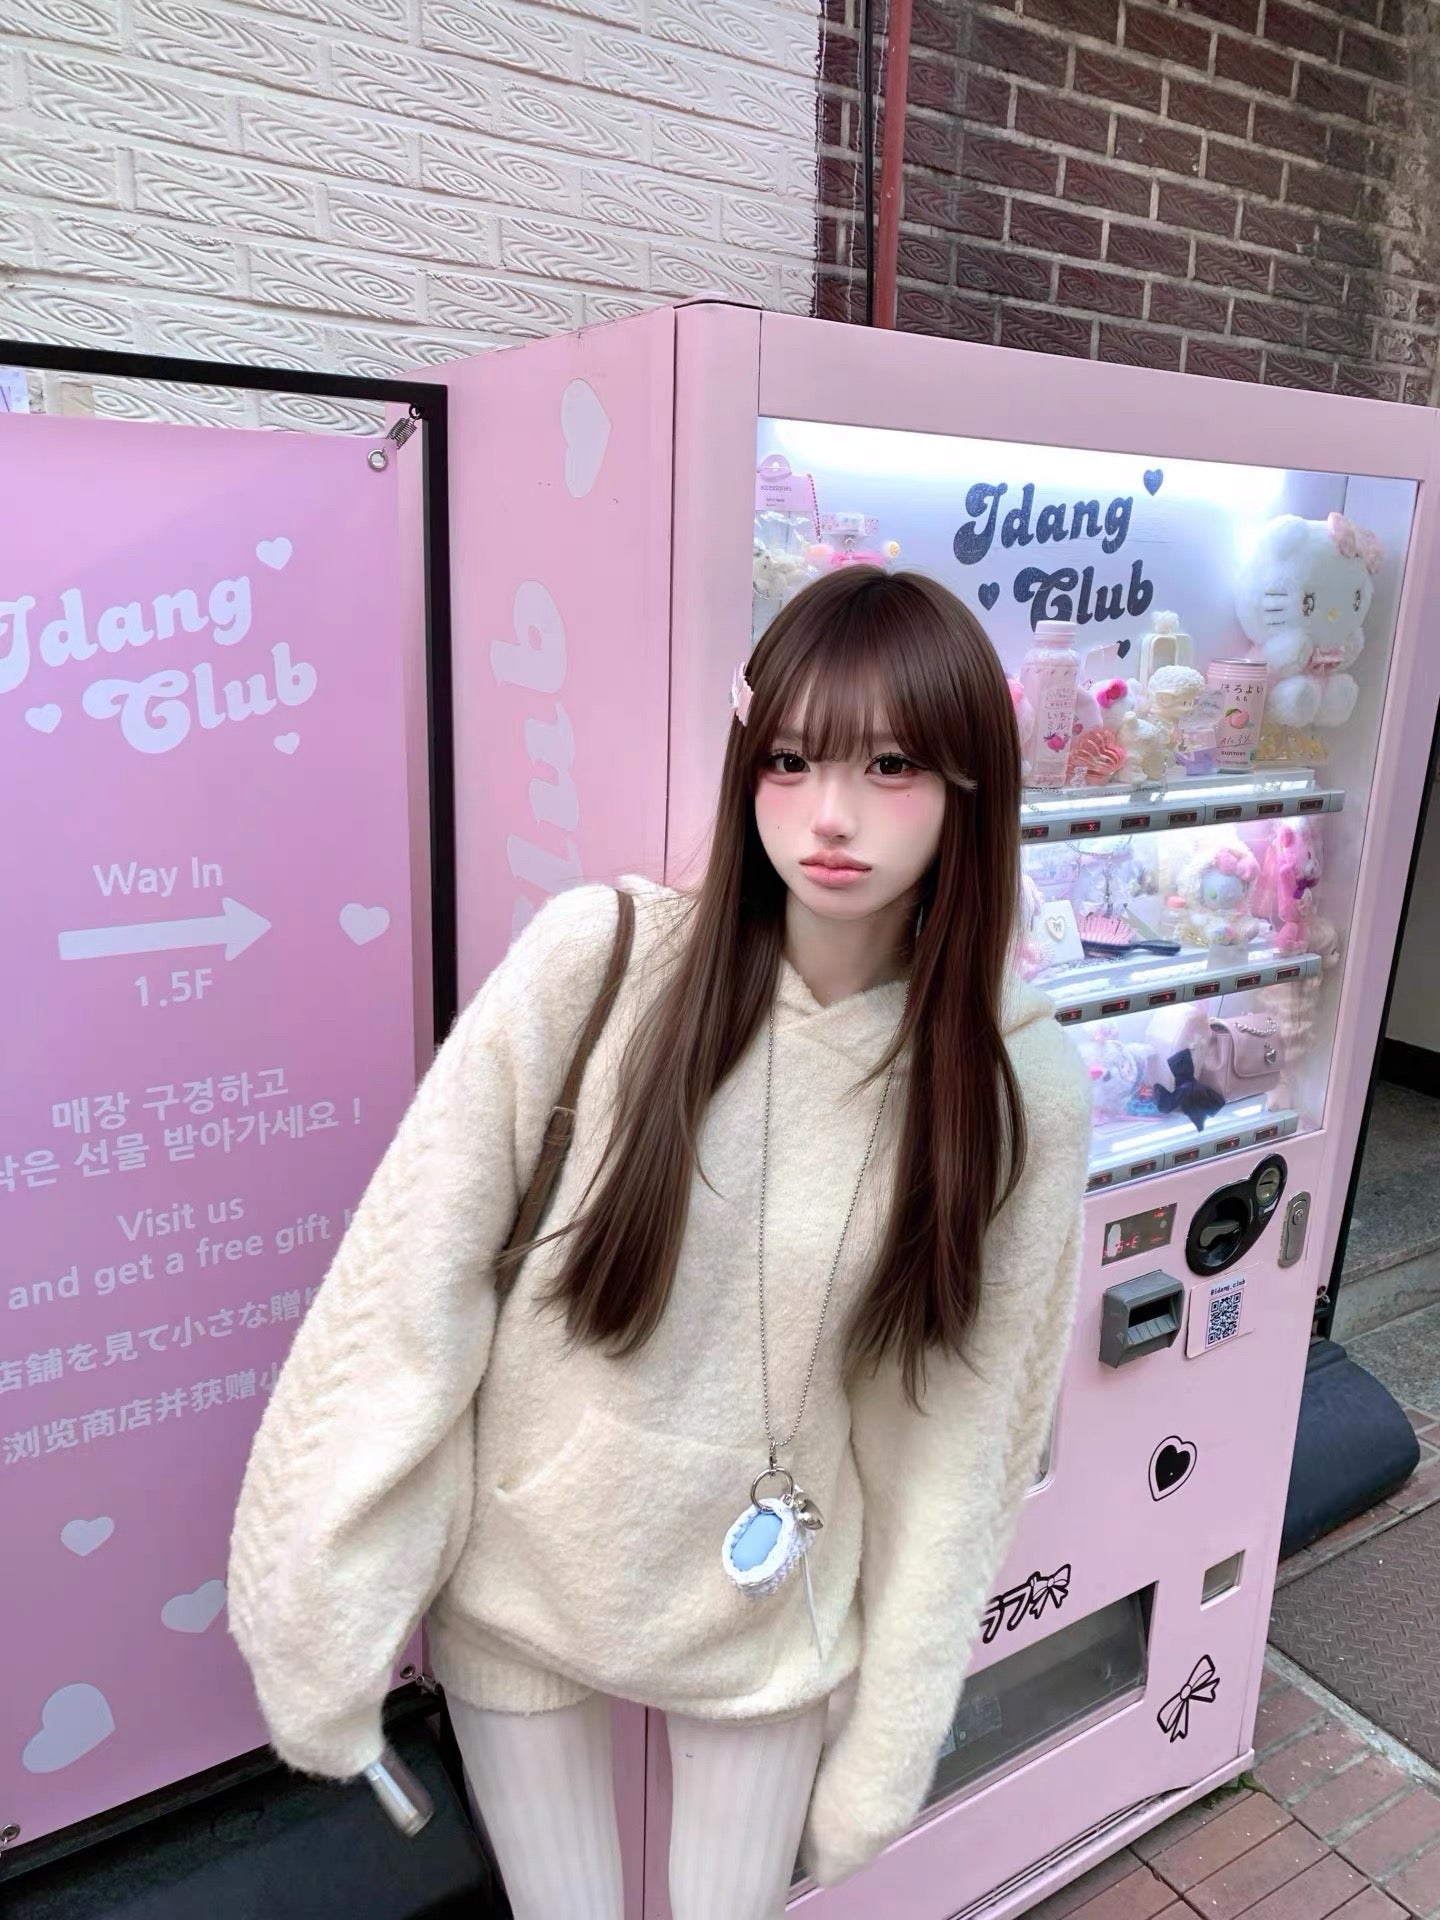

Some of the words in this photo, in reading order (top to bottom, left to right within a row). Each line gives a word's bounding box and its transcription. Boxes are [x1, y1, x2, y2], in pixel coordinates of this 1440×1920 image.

[1013, 559, 1154, 633] Club
[82, 642, 317, 754] Club
[1221, 682, 1264, 695] ほろよい
[490, 579, 584, 940] lub
[92, 861, 178, 898] Way
[191, 856, 223, 889] In
[134, 967, 213, 1008] 1.5F
[52, 1092, 131, 1135] 매장
[142, 1067, 289, 1121] 구경하고
[74, 1132, 150, 1178] 선물
[163, 1101, 340, 1163] 받아가세요
[353, 1097, 362, 1125] !
[116, 1202, 196, 1242] Visit
[207, 1197, 245, 1224] us
[8, 1265, 80, 1311] and
[94, 1253, 155, 1296] get
[165, 1252, 185, 1275] a
[195, 1233, 264, 1268] free
[275, 1212, 331, 1255] gift
